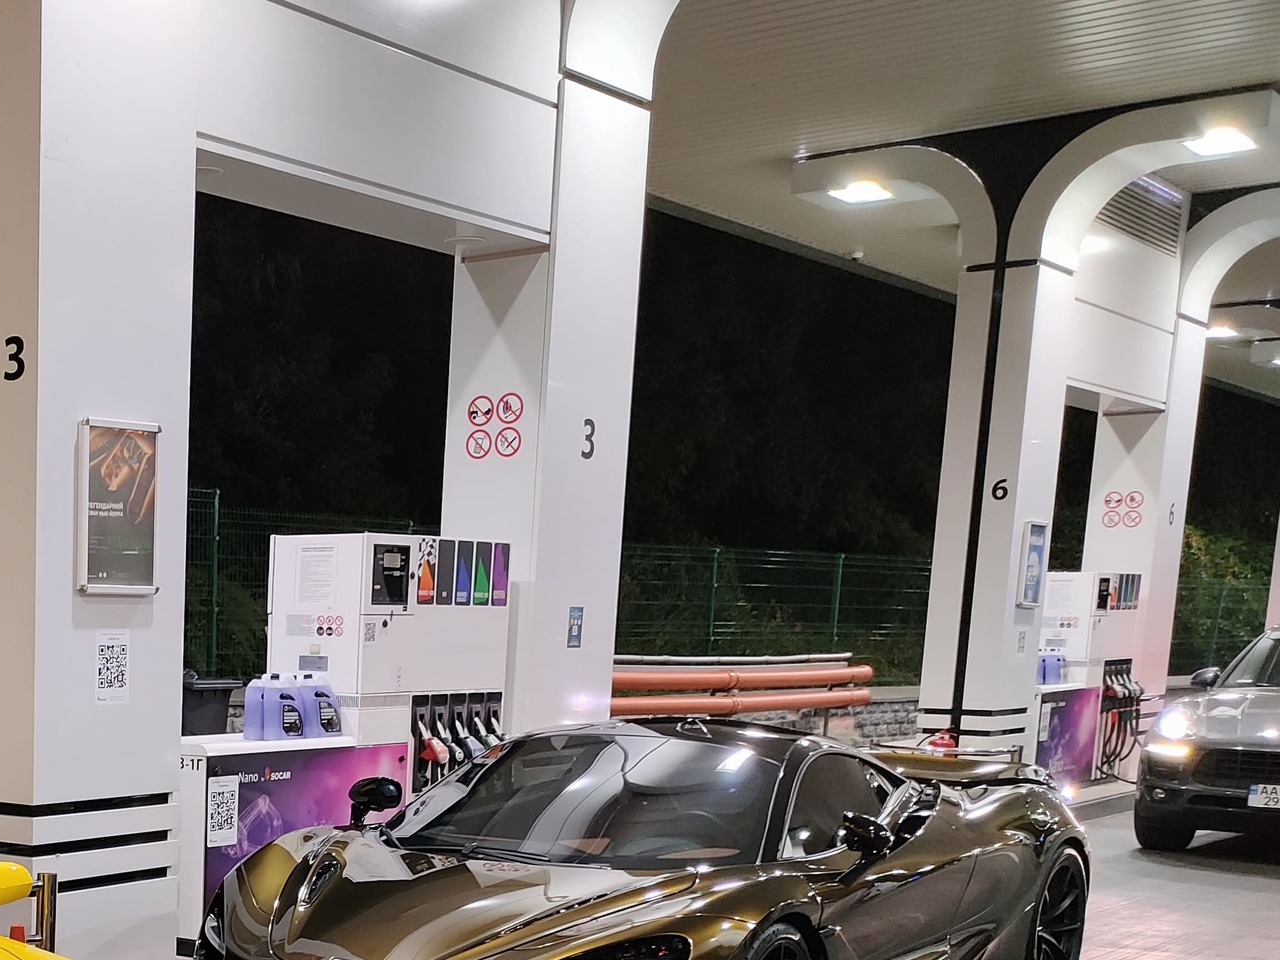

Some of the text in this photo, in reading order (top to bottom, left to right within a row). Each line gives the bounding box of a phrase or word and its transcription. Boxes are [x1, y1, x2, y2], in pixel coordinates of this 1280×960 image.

[3, 335, 25, 381] 3
[580, 418, 596, 460] 3
[991, 478, 1008, 501] 6
[1168, 501, 1175, 526] 6
[238, 772, 259, 783] Nano
[270, 771, 291, 780] SOCAR
[1261, 786, 1278, 796] AA
